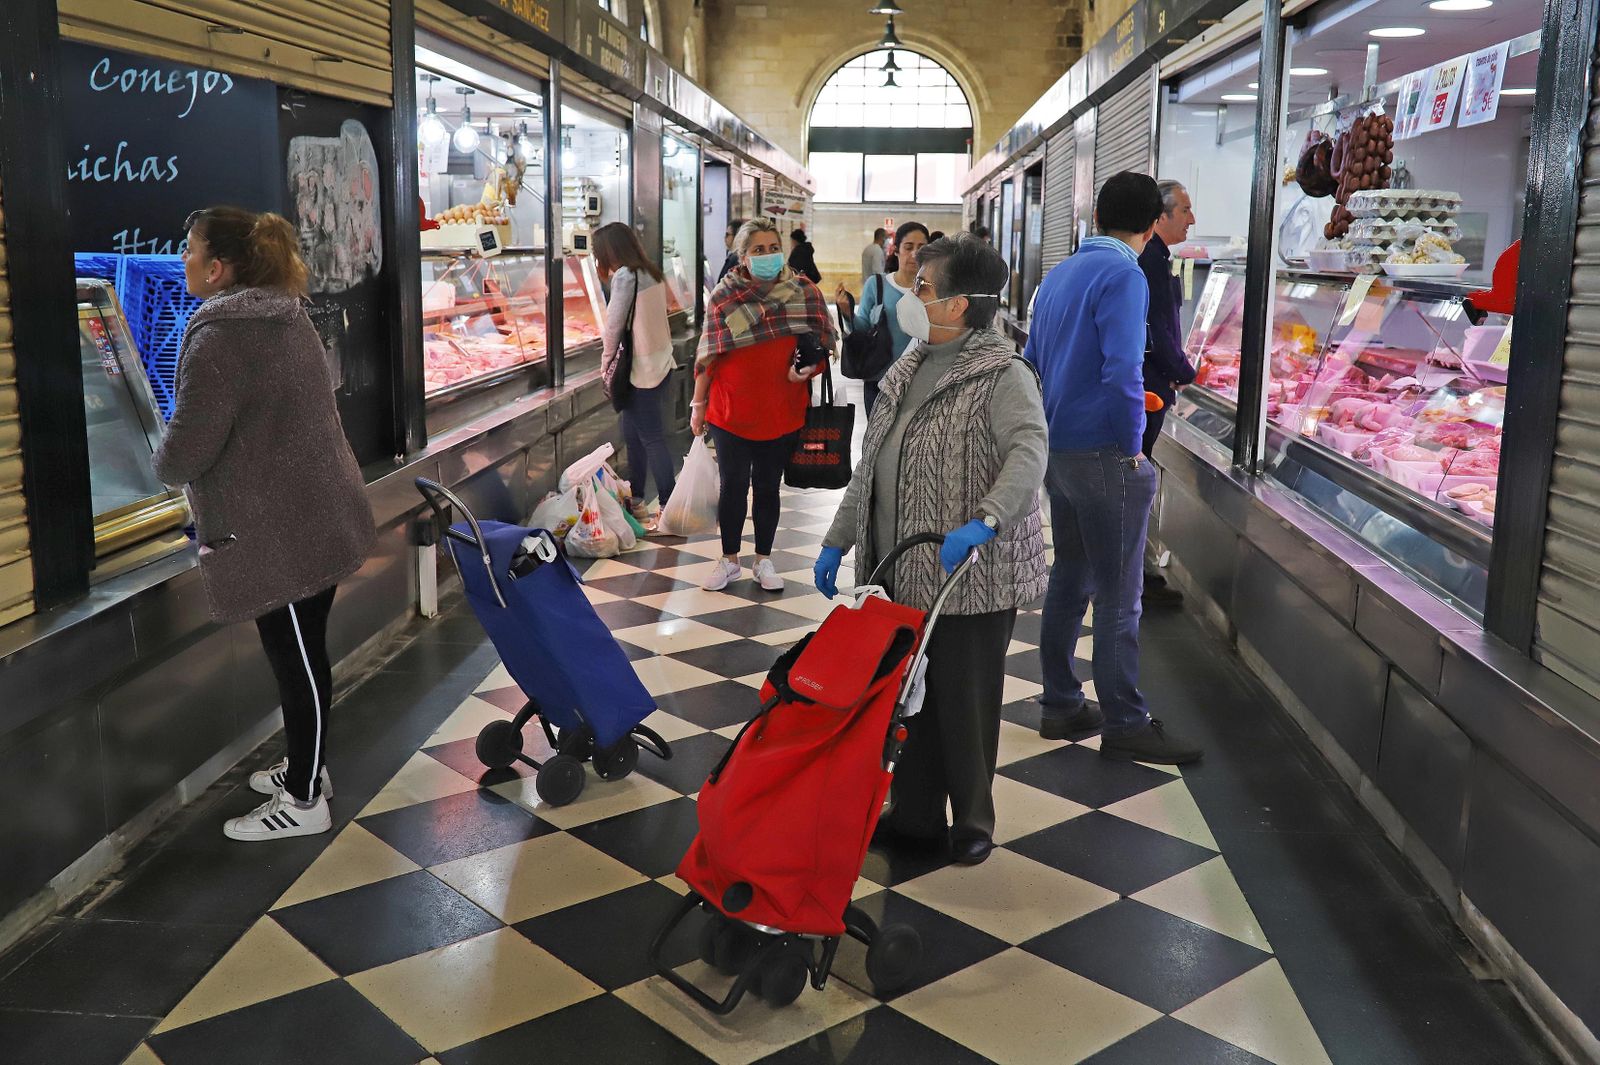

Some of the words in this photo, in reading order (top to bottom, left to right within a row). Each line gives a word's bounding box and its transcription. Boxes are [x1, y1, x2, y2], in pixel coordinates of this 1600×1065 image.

[599, 18, 607, 41] LA
[90, 57, 234, 119] Conejos
[112, 227, 190, 255] Hue
